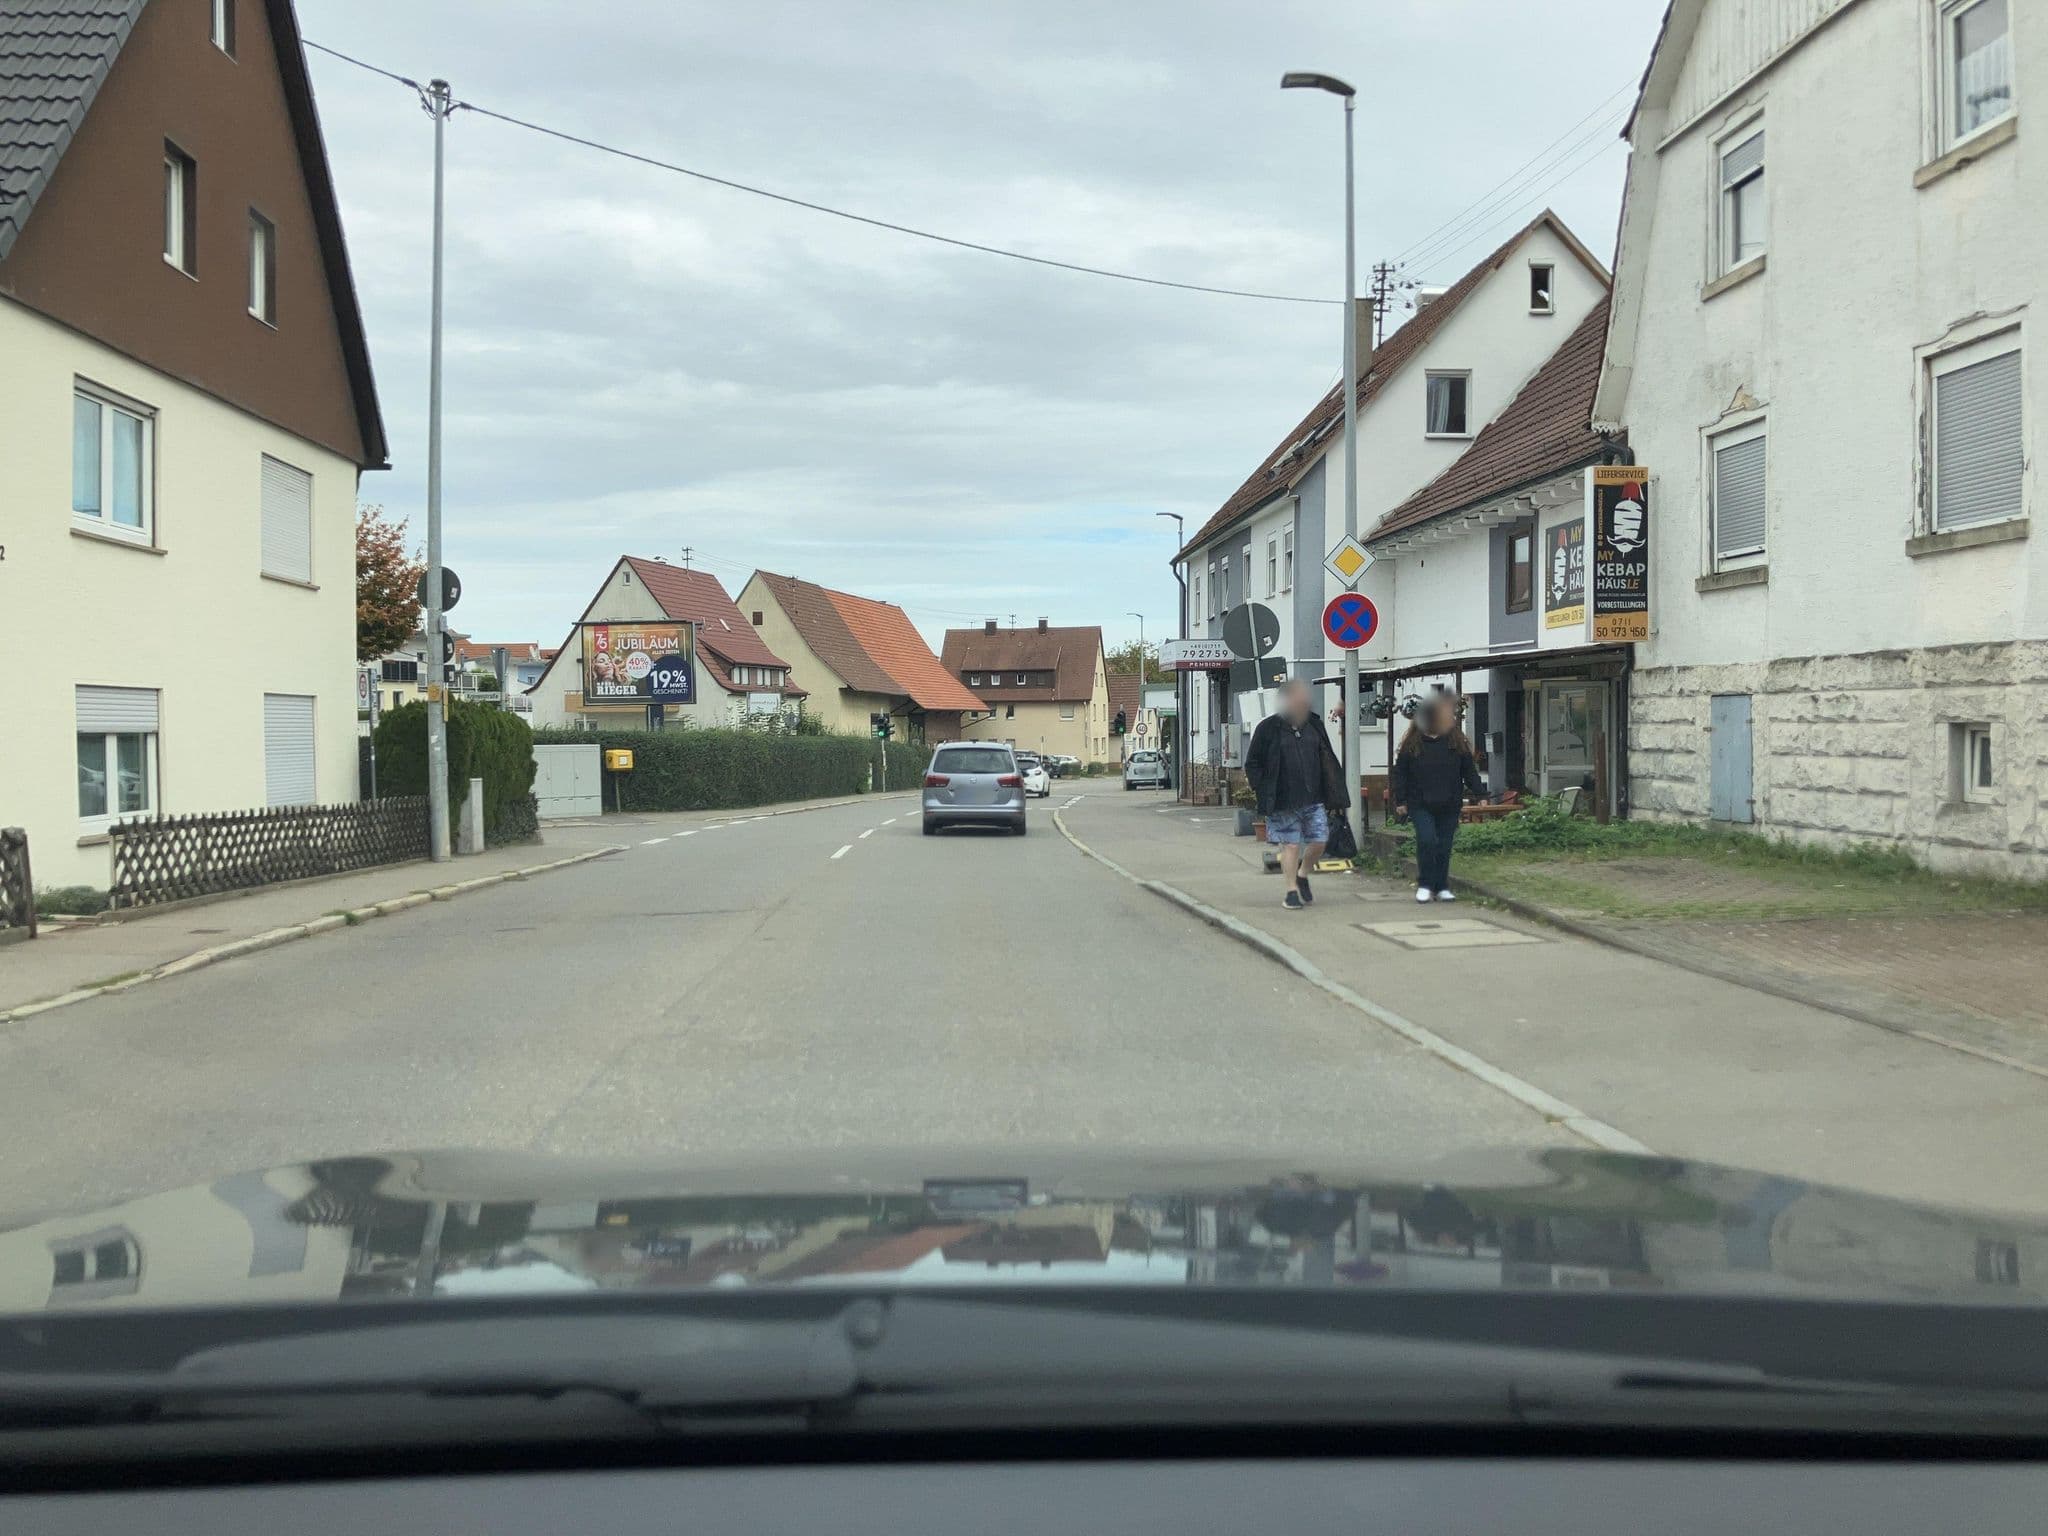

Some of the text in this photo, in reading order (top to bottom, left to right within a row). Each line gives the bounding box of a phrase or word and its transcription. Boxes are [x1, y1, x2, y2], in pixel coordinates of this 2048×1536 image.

[1597, 470, 1645, 478] LIEFERSERVICE
[1570, 525, 1583, 544] MY
[1569, 545, 1584, 569] KE
[1597, 551, 1614, 561] MY
[1597, 563, 1646, 576] KEBAP
[1597, 601, 1646, 609] VORBESTELLUNGEN
[1612, 618, 1631, 626] 0711
[1596, 627, 1646, 637] 50 473 450
[596, 633, 607, 649] 75
[615, 634, 679, 650] JUBILÄUM
[1182, 650, 1228, 658] 792759
[628, 657, 649, 666] 40%
[650, 670, 686, 688] 19%
[596, 685, 637, 695] RIEGER
